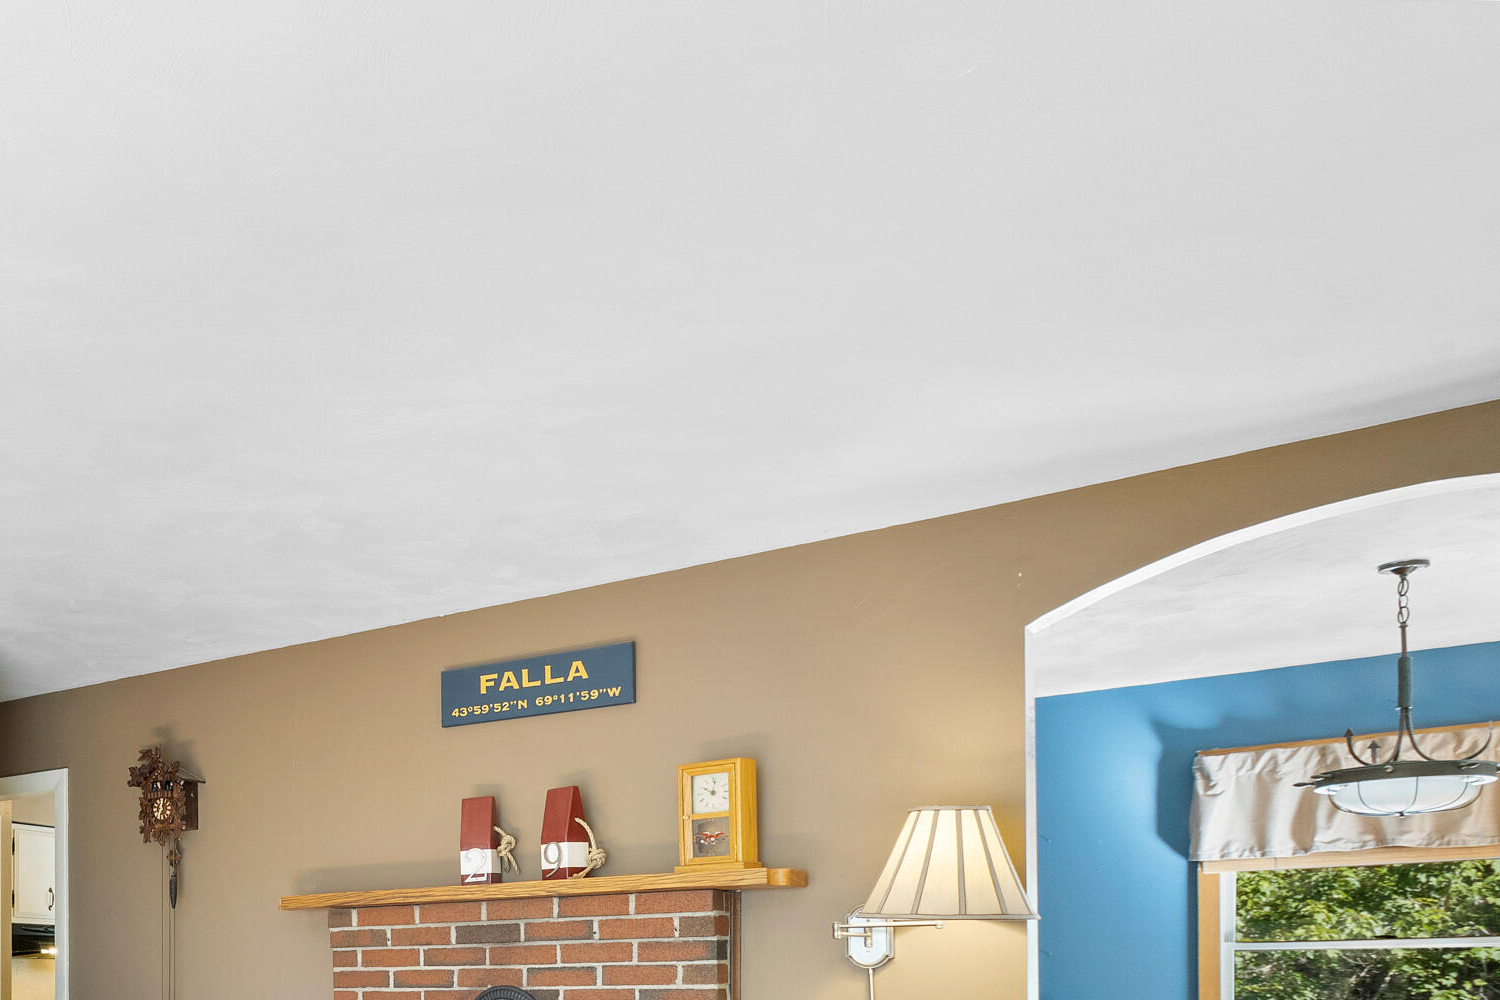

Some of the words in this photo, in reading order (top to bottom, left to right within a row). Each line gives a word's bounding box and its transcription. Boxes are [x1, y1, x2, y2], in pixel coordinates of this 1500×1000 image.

[480, 660, 589, 694] FALLA
[464, 847, 488, 883] 2
[543, 841, 564, 878] 9
